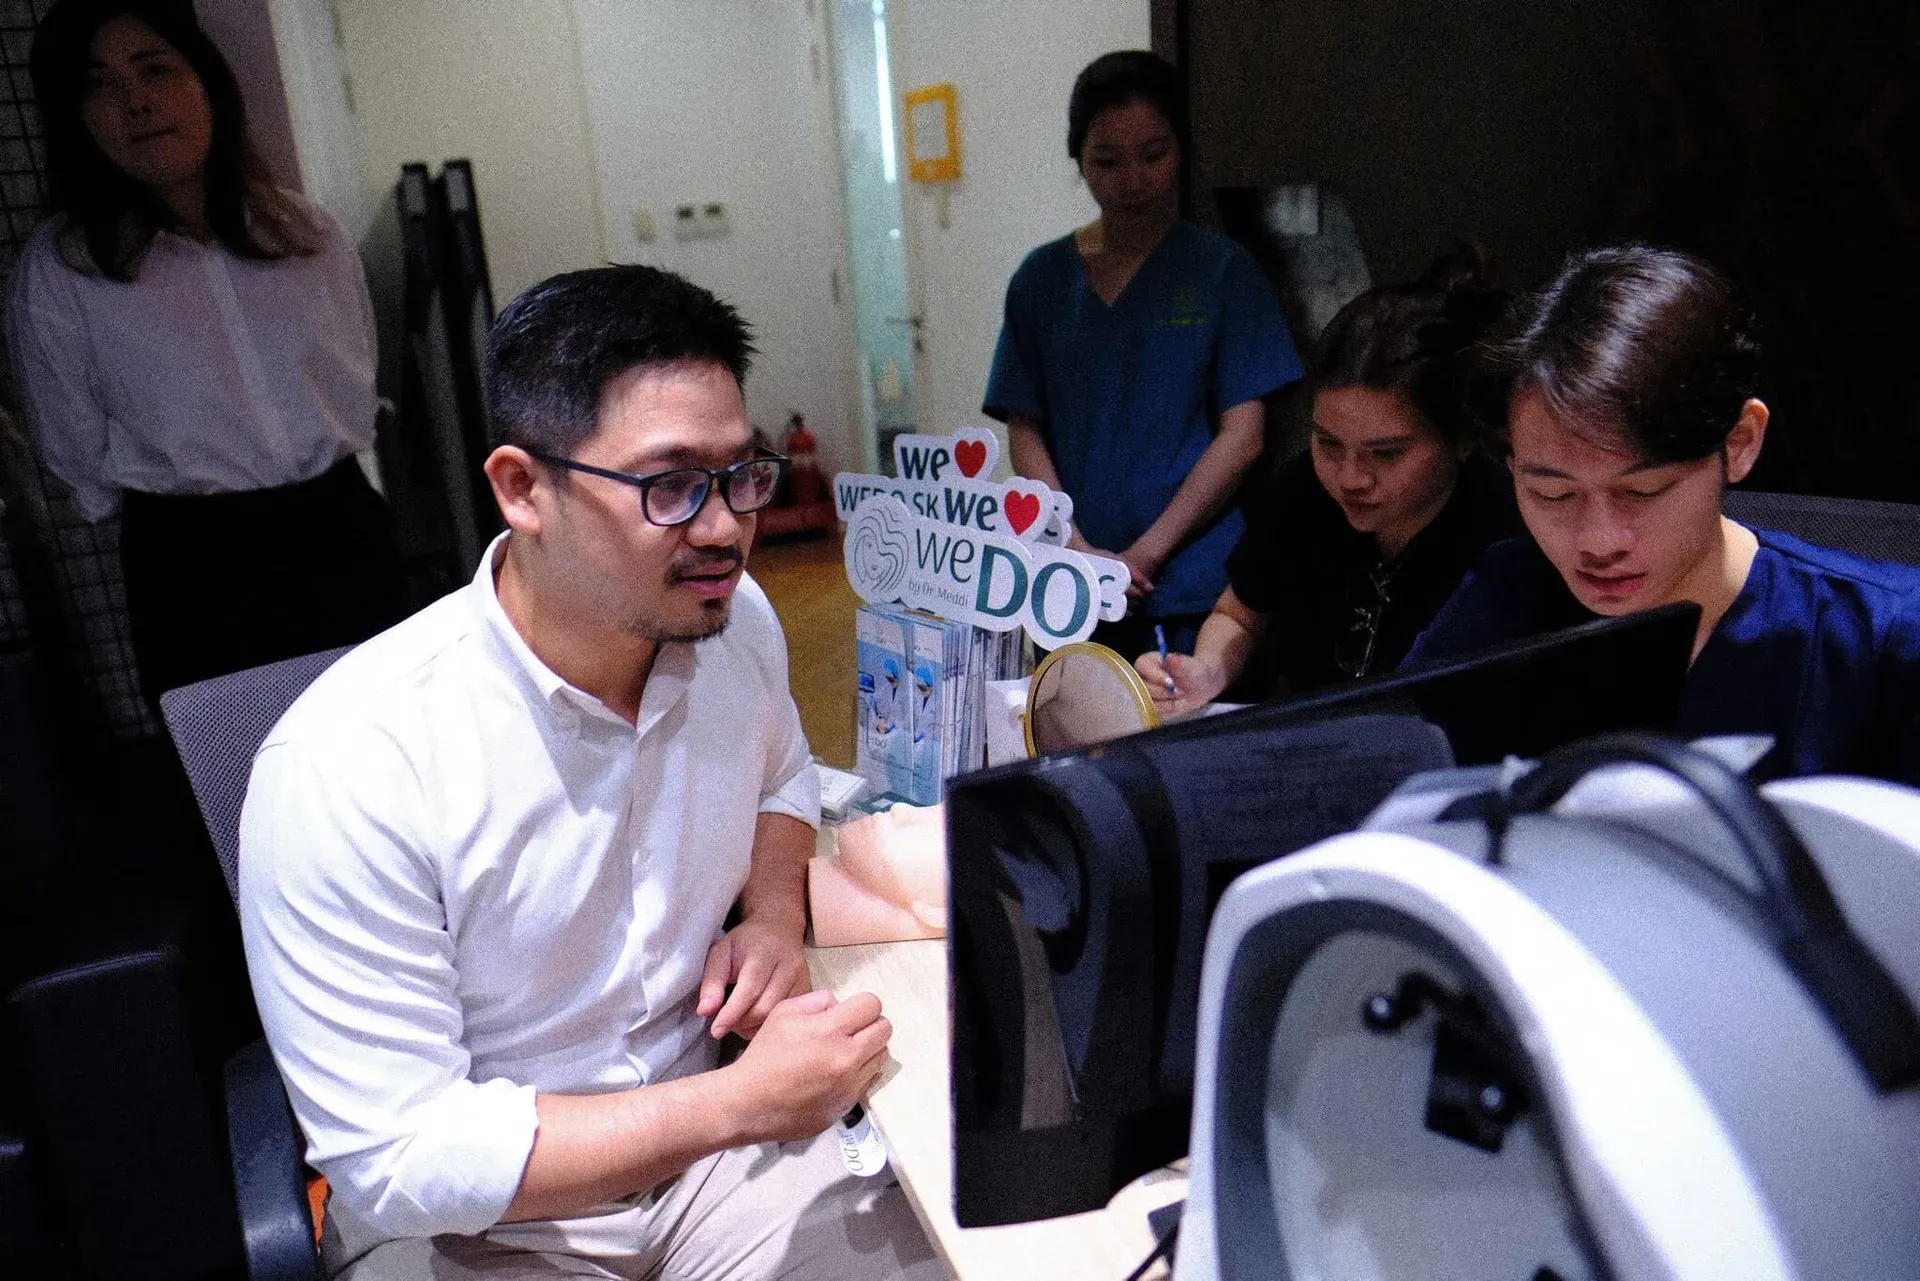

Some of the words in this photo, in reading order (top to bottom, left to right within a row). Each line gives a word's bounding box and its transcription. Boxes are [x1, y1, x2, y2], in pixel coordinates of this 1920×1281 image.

[900, 446, 950, 481] we
[944, 487, 998, 532] we
[908, 580, 921, 596] by
[938, 586, 969, 607] Meddi
